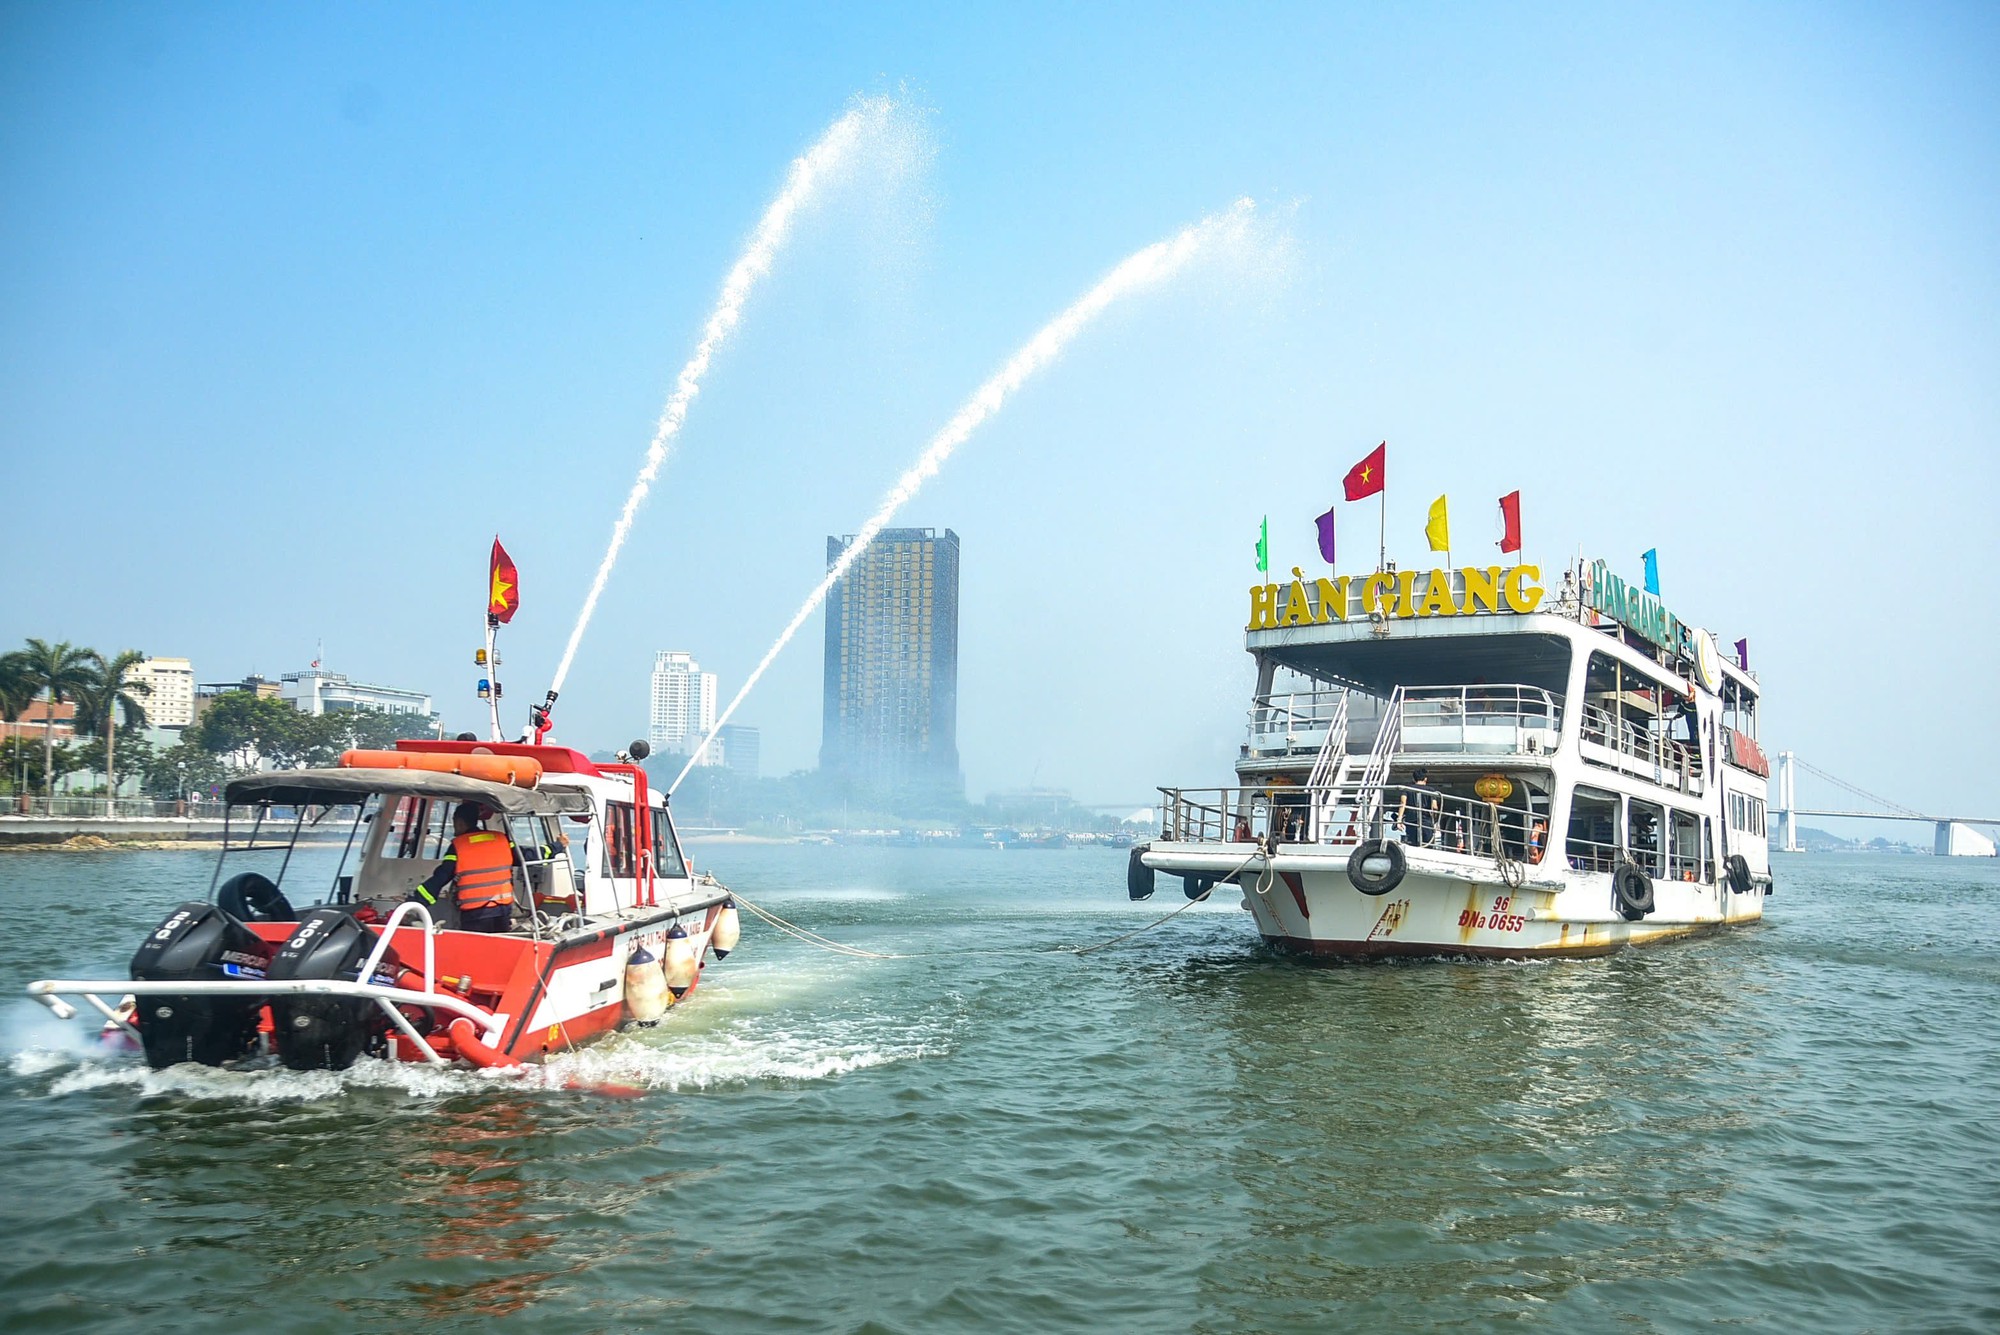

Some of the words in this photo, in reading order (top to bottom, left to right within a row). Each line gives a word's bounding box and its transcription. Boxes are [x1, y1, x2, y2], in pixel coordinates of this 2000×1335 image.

[1249, 567, 1351, 630] HÀN
[1362, 564, 1544, 618] GIANG
[1493, 895, 1510, 911] 96
[155, 911, 191, 940] 200
[290, 919, 324, 949] 200
[1458, 910, 1486, 929] ĐNa
[1488, 913, 1525, 933] 0655
[221, 950, 269, 968] MERCUR
